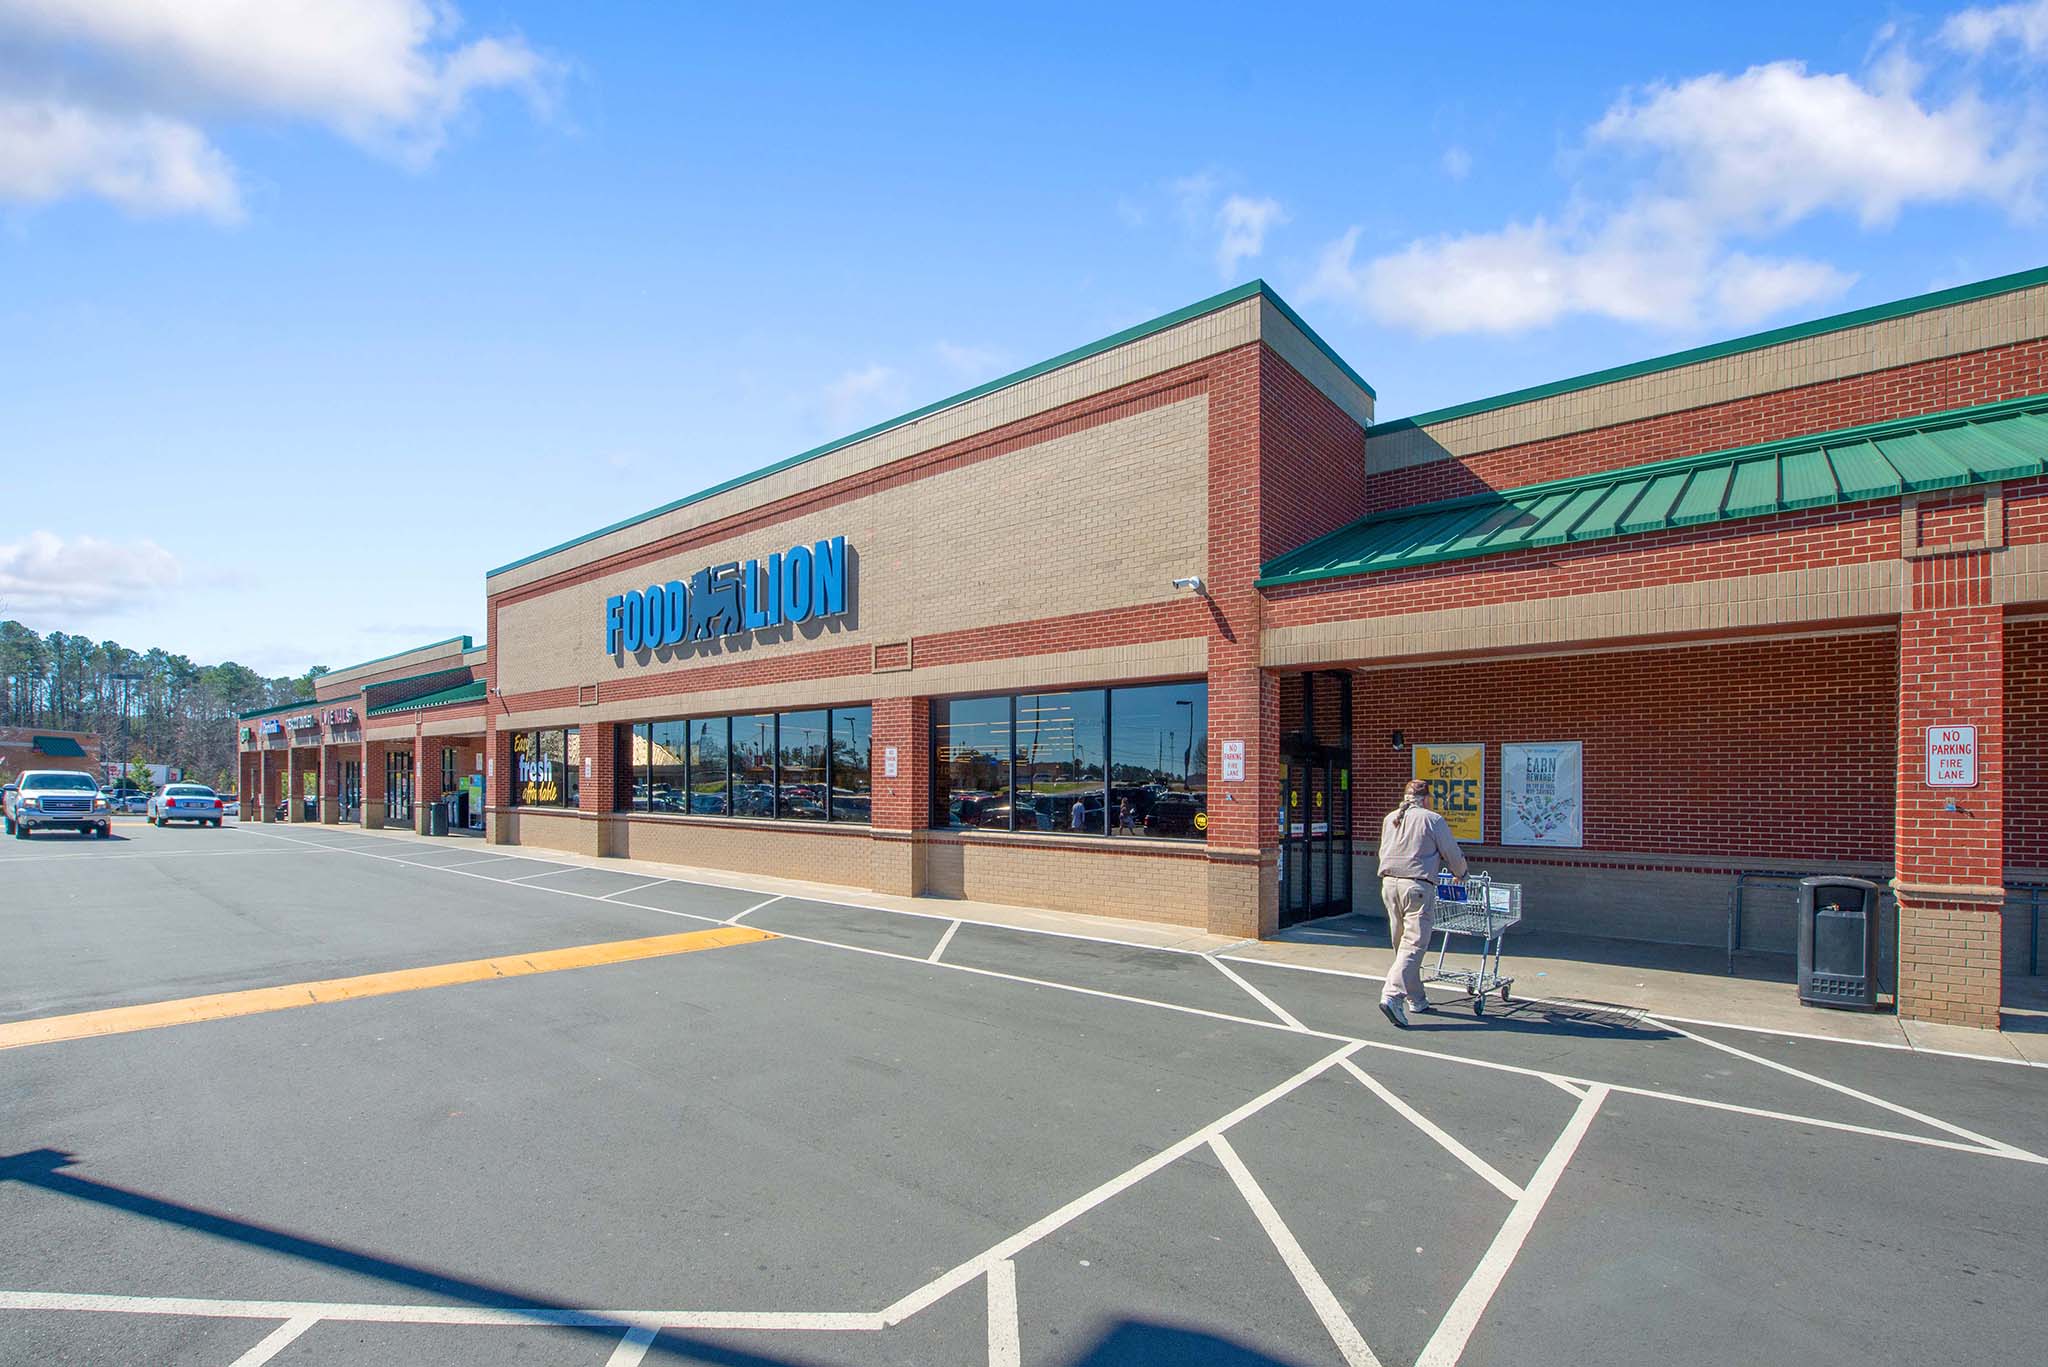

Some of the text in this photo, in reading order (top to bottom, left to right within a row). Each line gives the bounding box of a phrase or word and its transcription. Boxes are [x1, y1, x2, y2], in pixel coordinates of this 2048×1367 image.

[606, 535, 848, 656] FOOD LION
[1942, 731, 1960, 742] NO
[1229, 744, 1238, 752] NO
[1931, 744, 1972, 755] PARKING
[1431, 754, 1457, 766] BUY 2
[1526, 757, 1556, 773] EARN
[1940, 759, 1963, 768] FIRE
[519, 752, 552, 781] fresh
[1439, 766, 1454, 778] GET
[1526, 773, 1556, 783] REWARDS
[1938, 770, 1965, 780] LANE
[522, 781, 558, 804] affodable
